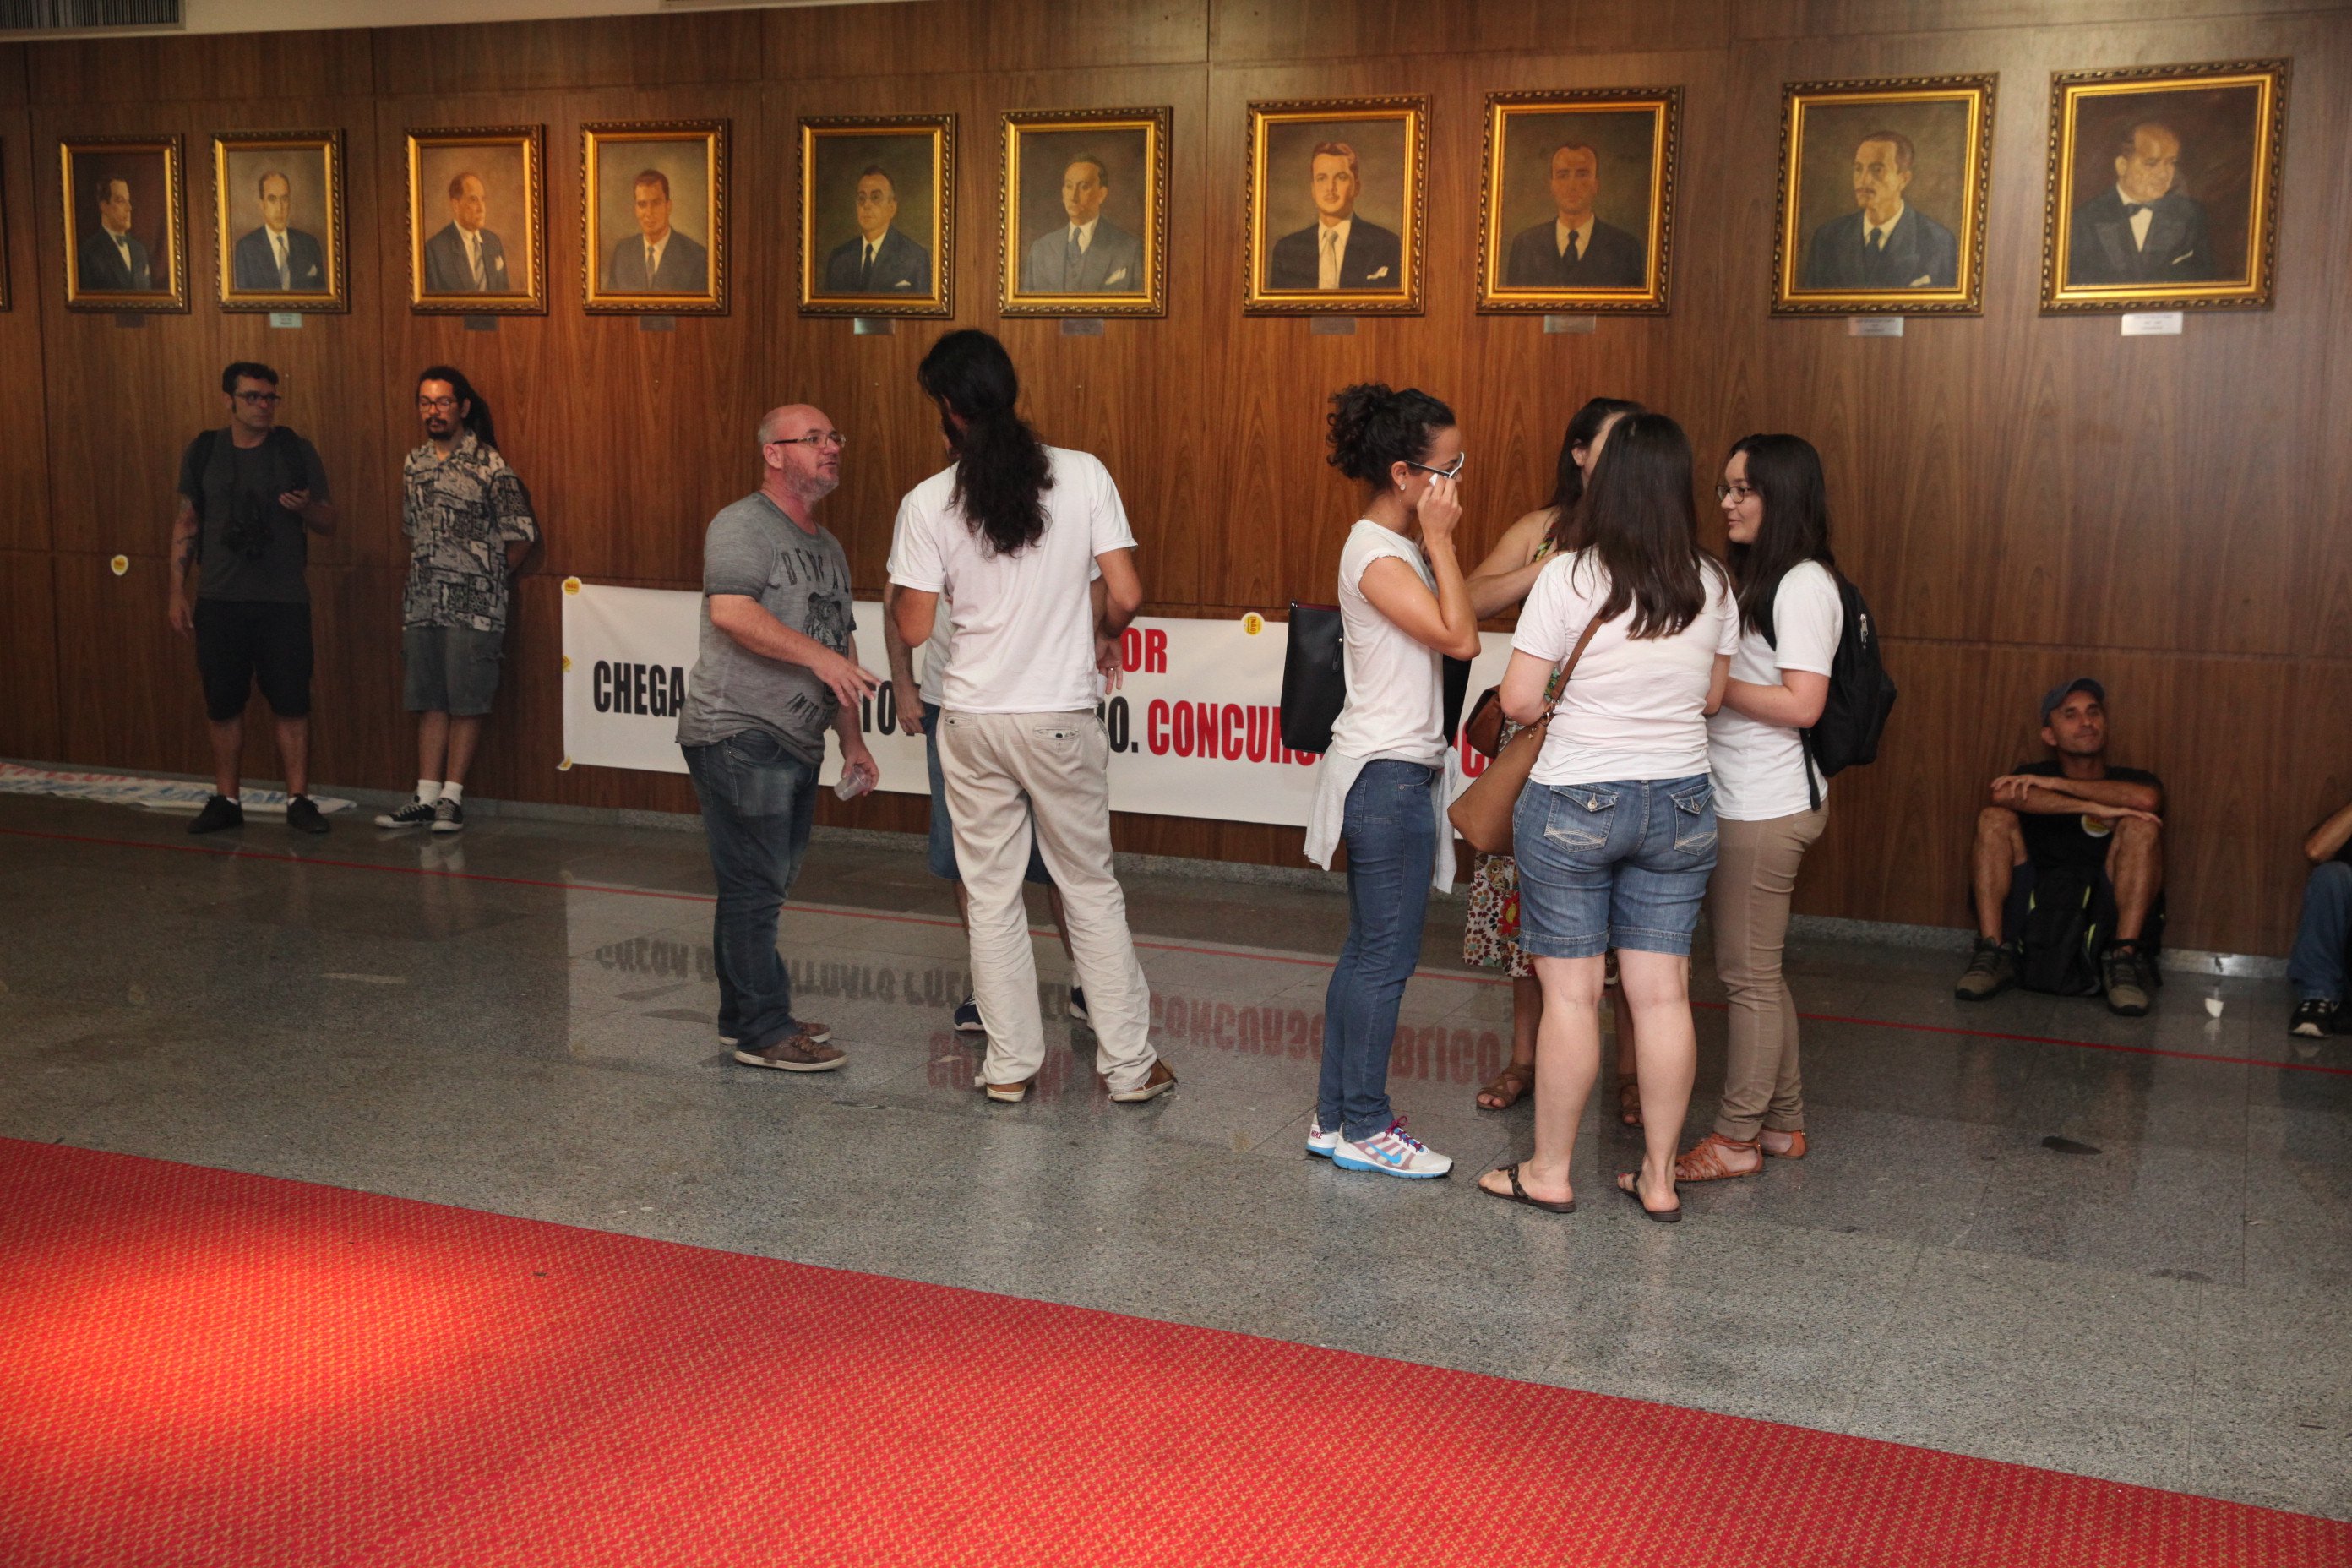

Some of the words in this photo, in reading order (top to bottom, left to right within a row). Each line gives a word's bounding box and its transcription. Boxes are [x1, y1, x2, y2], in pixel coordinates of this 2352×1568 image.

[1120, 627, 1167, 673] OR
[593, 660, 686, 717] CHEGA
[862, 679, 896, 735] TO
[1097, 695, 1139, 754] O.
[1147, 699, 1325, 766] CONCUR
